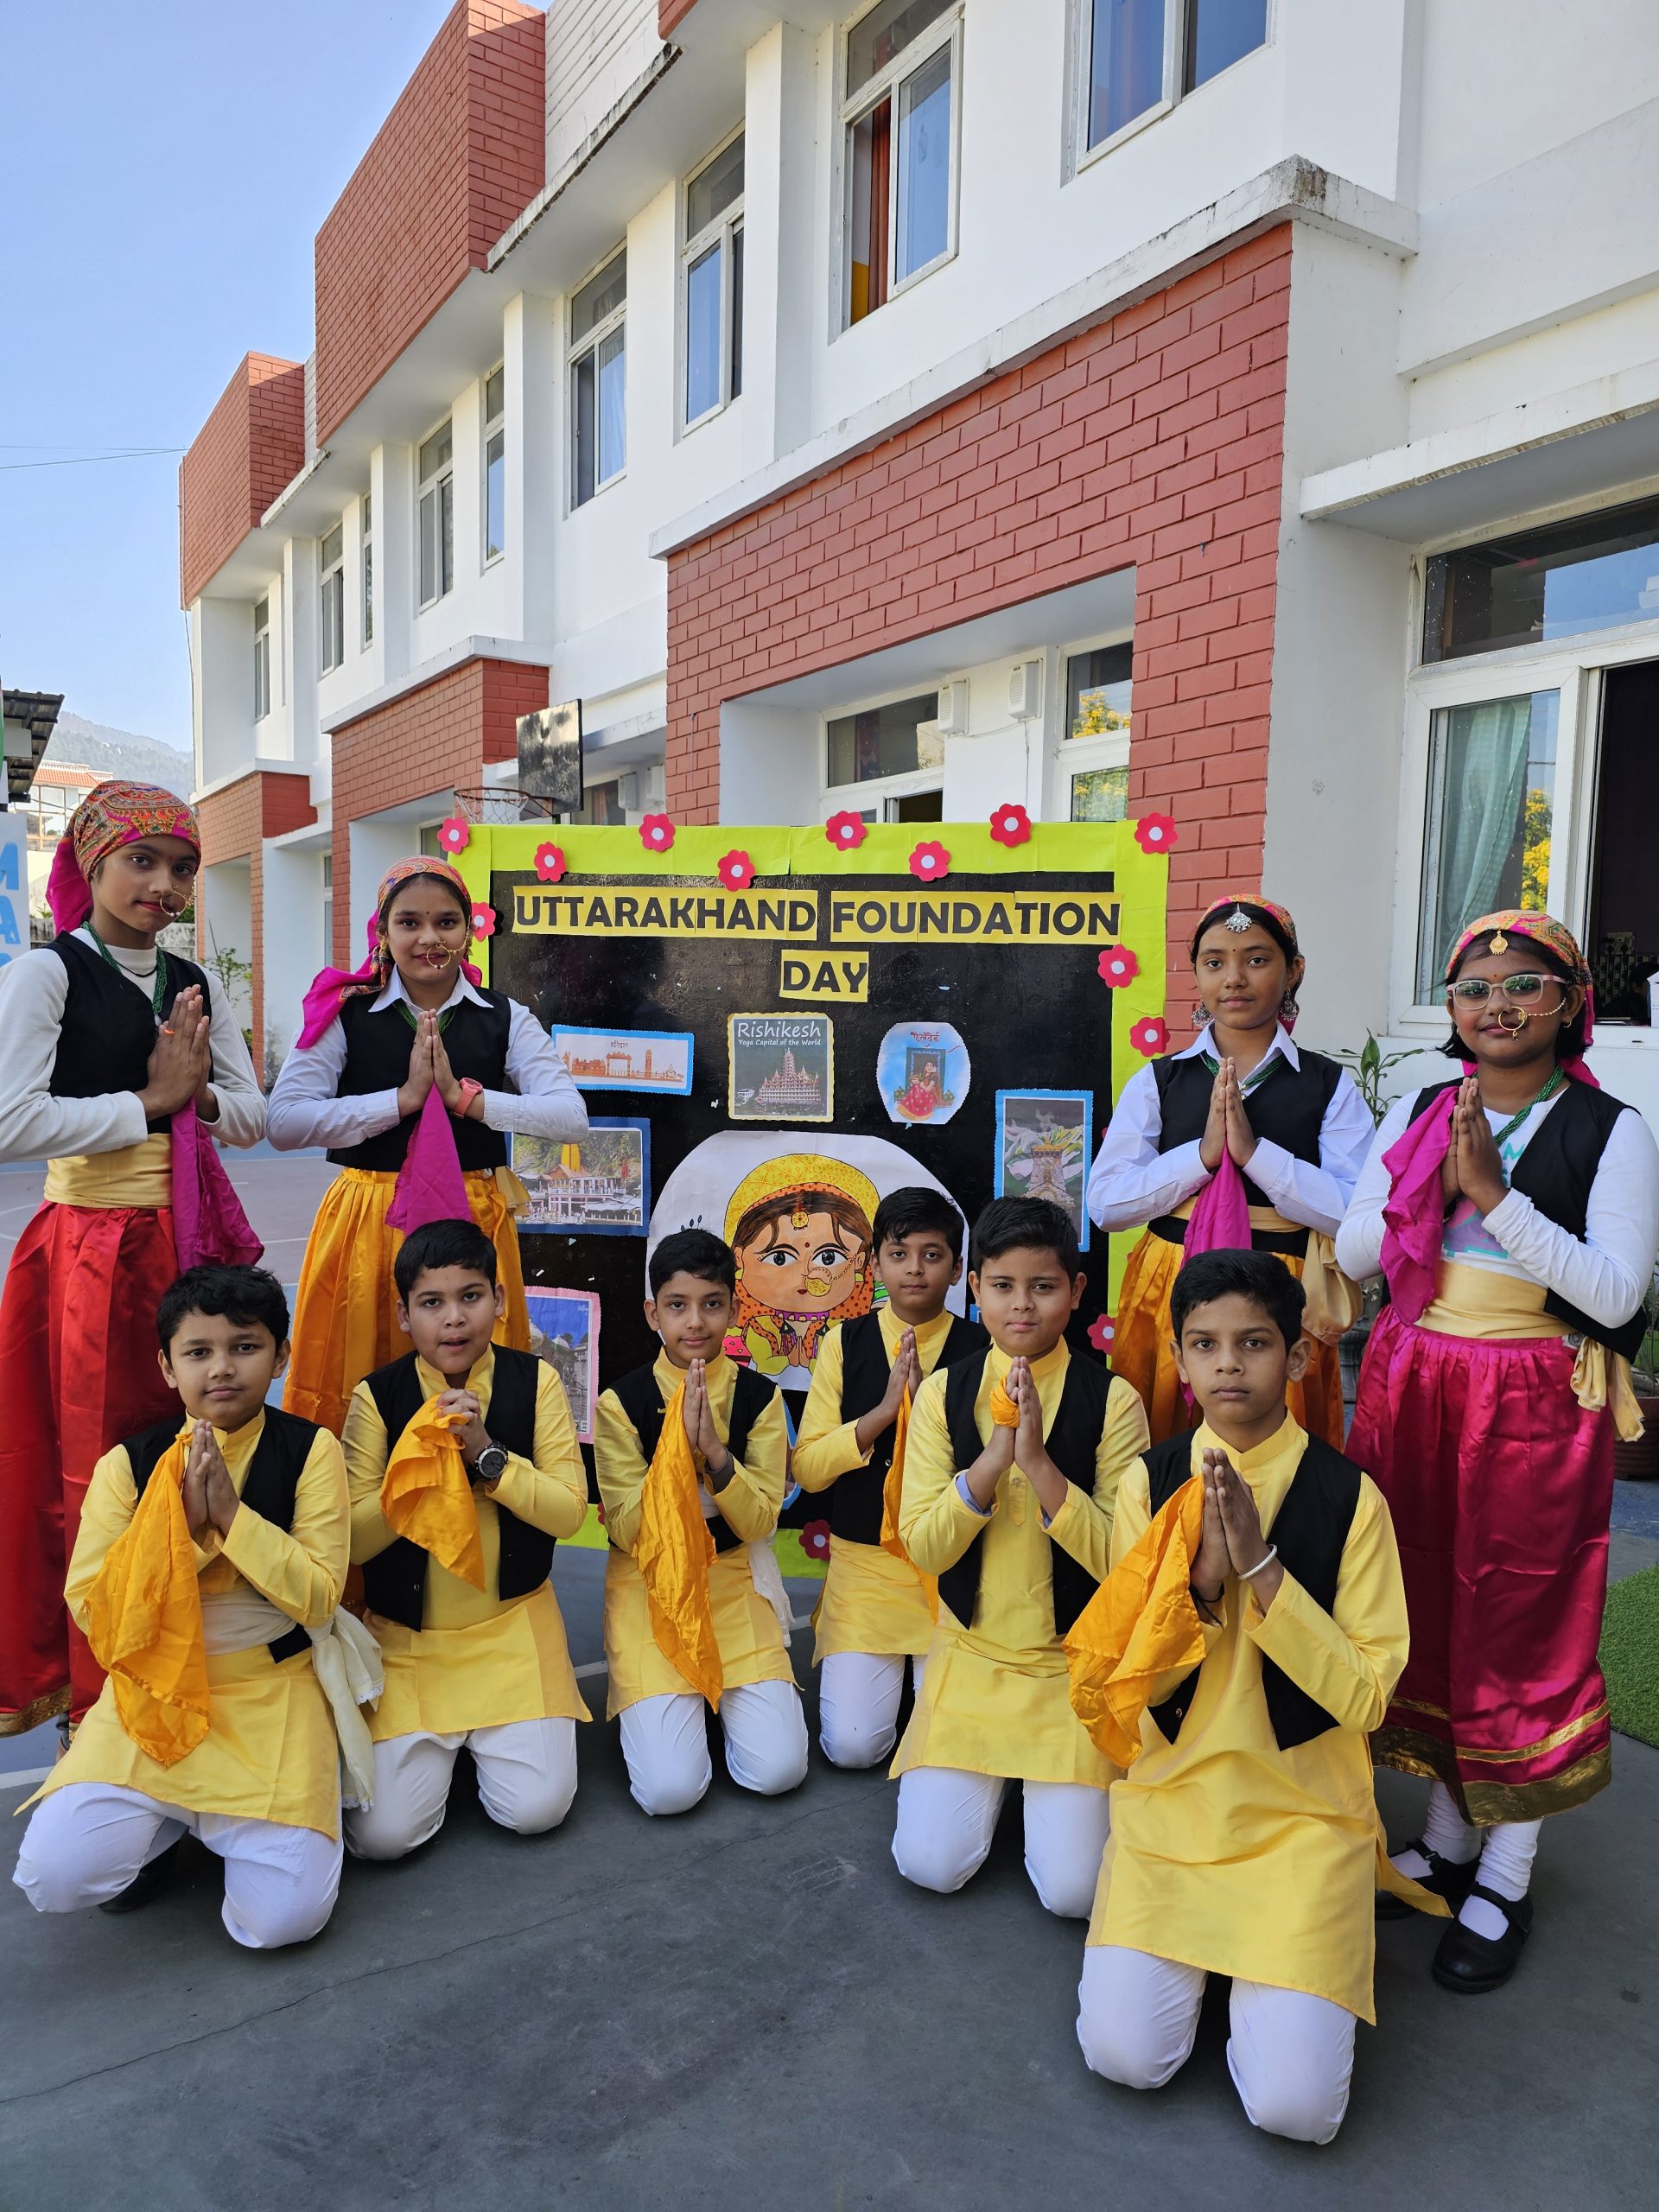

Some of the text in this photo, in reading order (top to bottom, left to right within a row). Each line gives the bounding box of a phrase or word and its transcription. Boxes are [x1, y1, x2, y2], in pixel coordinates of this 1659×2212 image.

[517, 895, 1121, 936] UTTARAKHAND FOUNDATION
[783, 960, 868, 993] DAY
[737, 1020, 821, 1038] Rishikesh
[738, 1039, 753, 1047] Yoga
[755, 1039, 779, 1047] Capital
